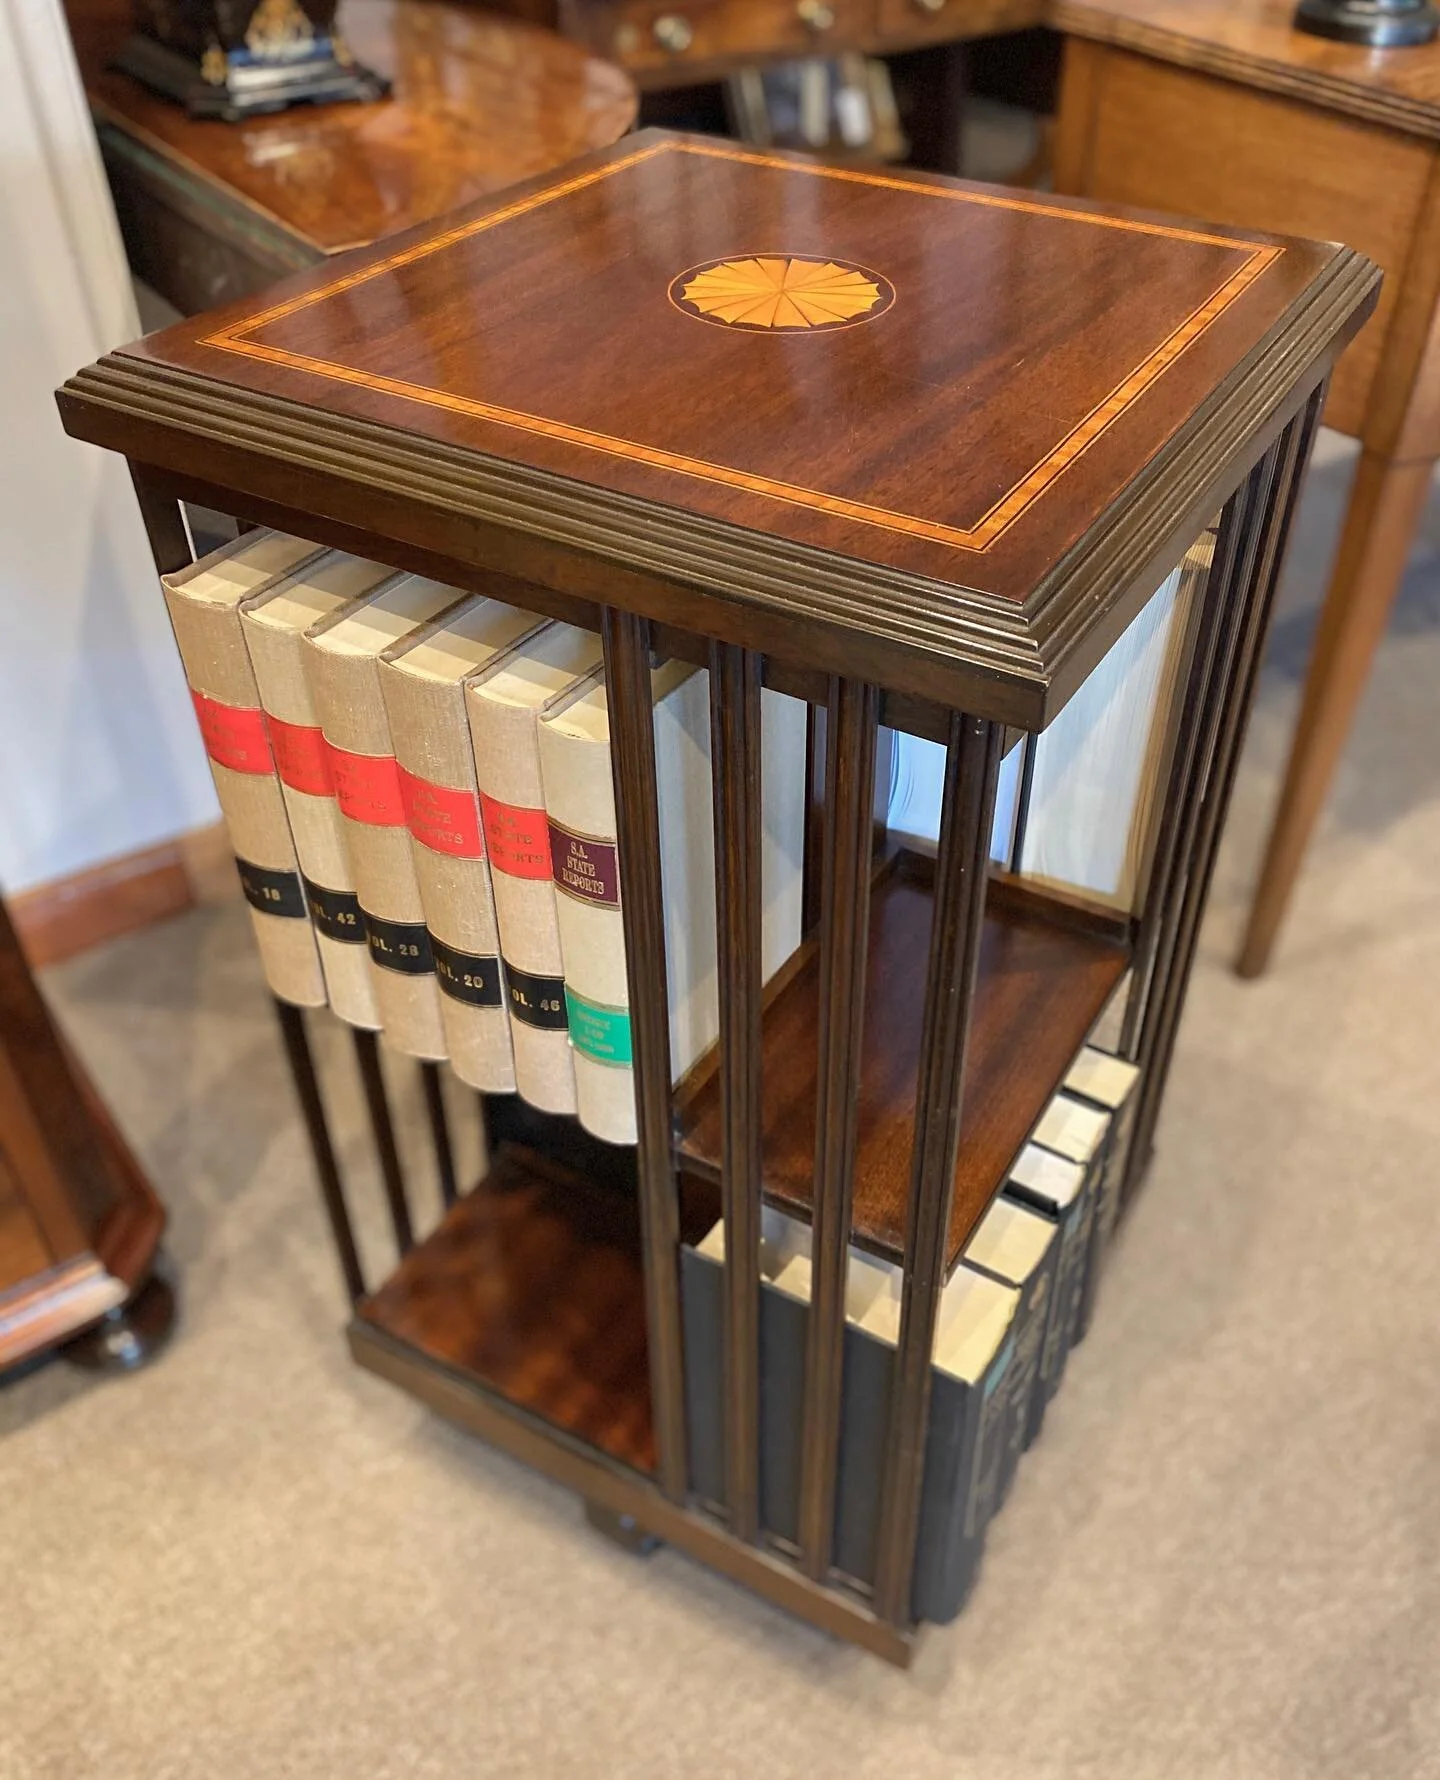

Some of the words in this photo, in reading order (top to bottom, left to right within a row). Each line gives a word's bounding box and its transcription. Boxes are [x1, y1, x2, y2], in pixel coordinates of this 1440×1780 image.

[411, 816, 464, 845] ORTS
[490, 823, 533, 845] STTE
[491, 842, 545, 864] RERTS
[570, 841, 588, 859] S.A.
[567, 855, 596, 877] STATE
[562, 865, 605, 895] REPORTS
[336, 912, 357, 926] 42
[371, 935, 393, 953] OL.
[399, 943, 420, 957] 28
[463, 974, 484, 989] 20
[511, 988, 534, 1008] OL.
[540, 999, 561, 1012] 46
